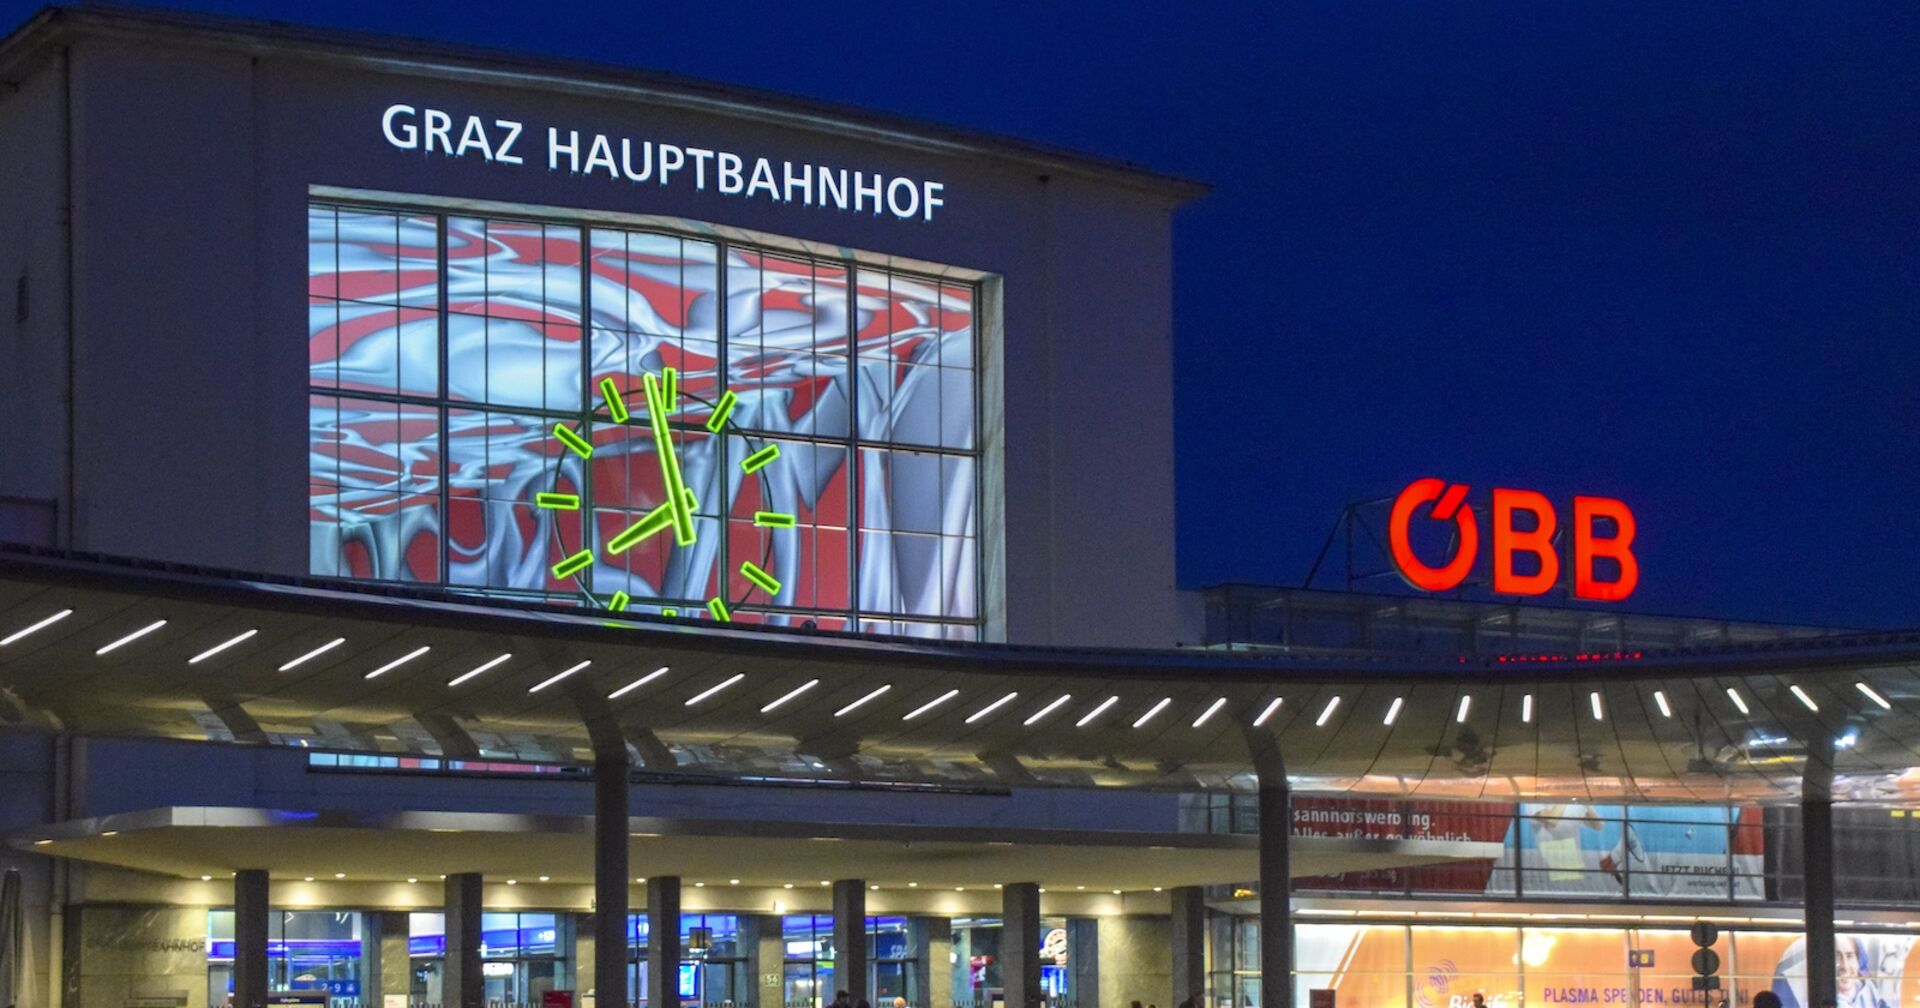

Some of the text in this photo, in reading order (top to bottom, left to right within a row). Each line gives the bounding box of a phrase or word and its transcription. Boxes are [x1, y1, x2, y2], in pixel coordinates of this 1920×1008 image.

[382, 104, 945, 222] GRAZ HAUPTBAHNHOF
[1389, 477, 1639, 602] ÖBB
[1544, 988, 1598, 1003] PLASMA
[1603, 988, 1667, 1005] SPEDEN,
